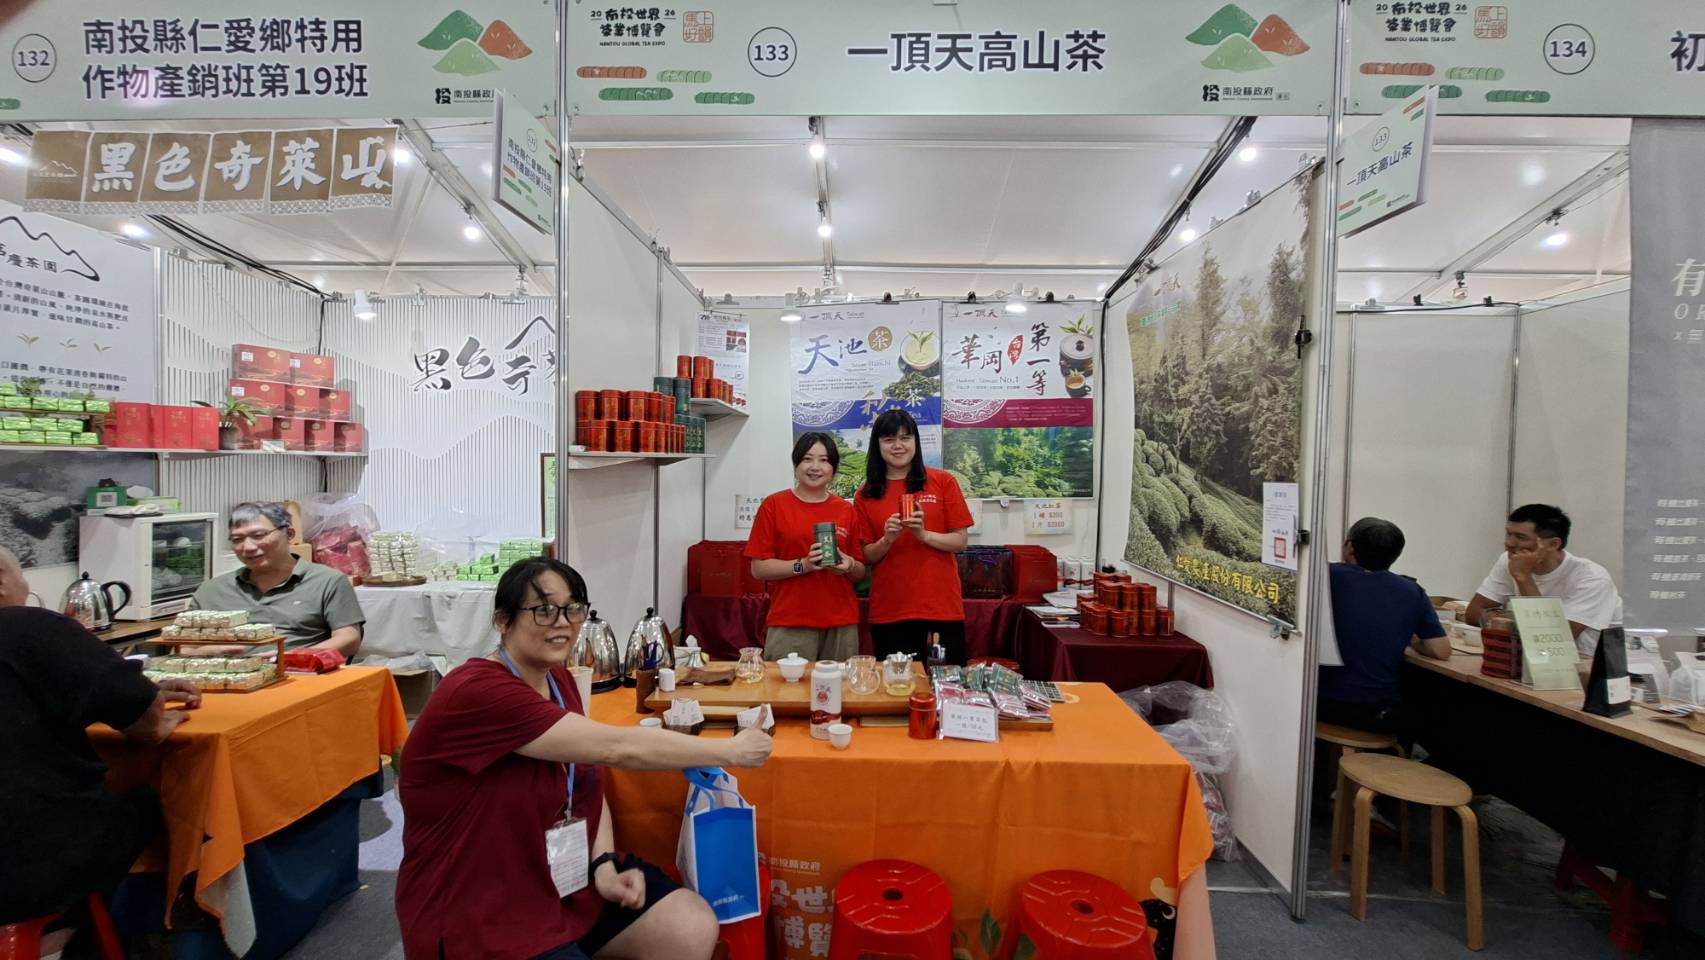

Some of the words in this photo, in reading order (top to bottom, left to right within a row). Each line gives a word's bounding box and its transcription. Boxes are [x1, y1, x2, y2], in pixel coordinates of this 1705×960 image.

[605, 7, 660, 21] 南投世界
[1391, 2, 1450, 15] 南投世界
[83, 20, 363, 53] 南投縣仁愛鄉特用
[600, 22, 666, 37] 茶業博覽會
[1385, 17, 1456, 32] 茶業博覽會
[17, 50, 50, 67] 132
[753, 43, 789, 62] 133
[848, 31, 1106, 72] 一頂天高山茶
[1549, 40, 1587, 58] 134
[1671, 31, 1705, 71] 初
[82, 65, 368, 98] 作物產銷班第19班
[1222, 87, 1273, 96] 南投縣政府
[92, 135, 393, 192] 黑色奇萊山
[1346, 141, 1413, 185] 一頂天高山茶
[1672, 258, 1705, 297] 有
[798, 334, 867, 375] 天池
[873, 330, 889, 349] 茶
[1026, 322, 1051, 396] 第一等
[906, 389, 923, 408] 茶
